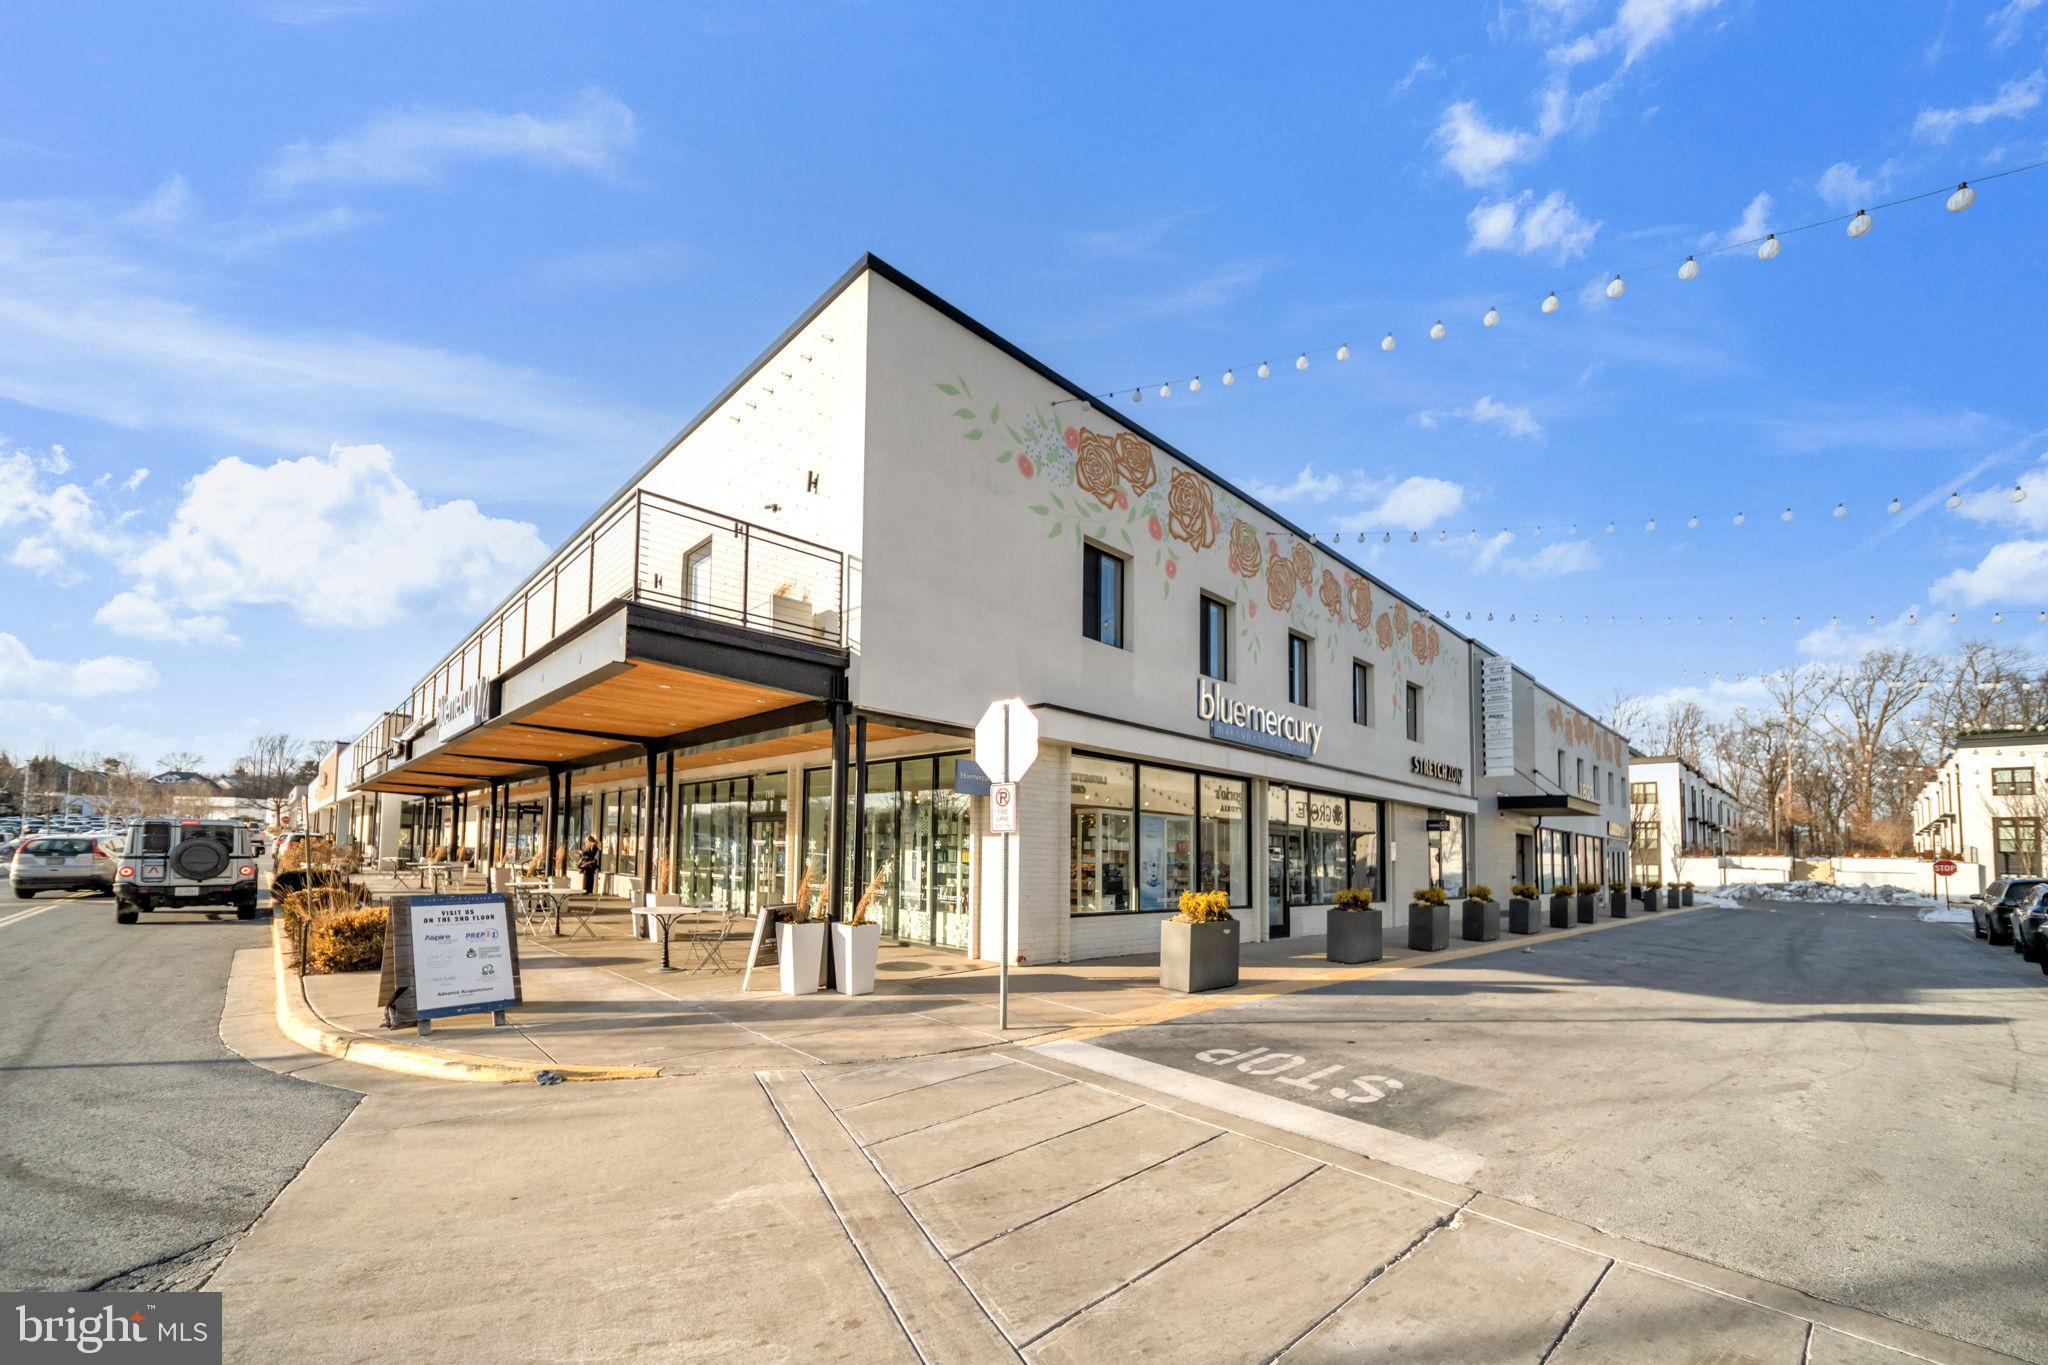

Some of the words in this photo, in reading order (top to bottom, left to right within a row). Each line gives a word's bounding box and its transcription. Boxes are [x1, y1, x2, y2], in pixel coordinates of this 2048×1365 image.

[1197, 678, 1322, 754] bluemercury
[1411, 756, 1448, 780] STRETCH
[1934, 864, 1957, 872] STOP
[465, 931, 485, 940] PREP
[461, 986, 494, 994] Acupuncture
[1195, 1046, 1404, 1103] STOP
